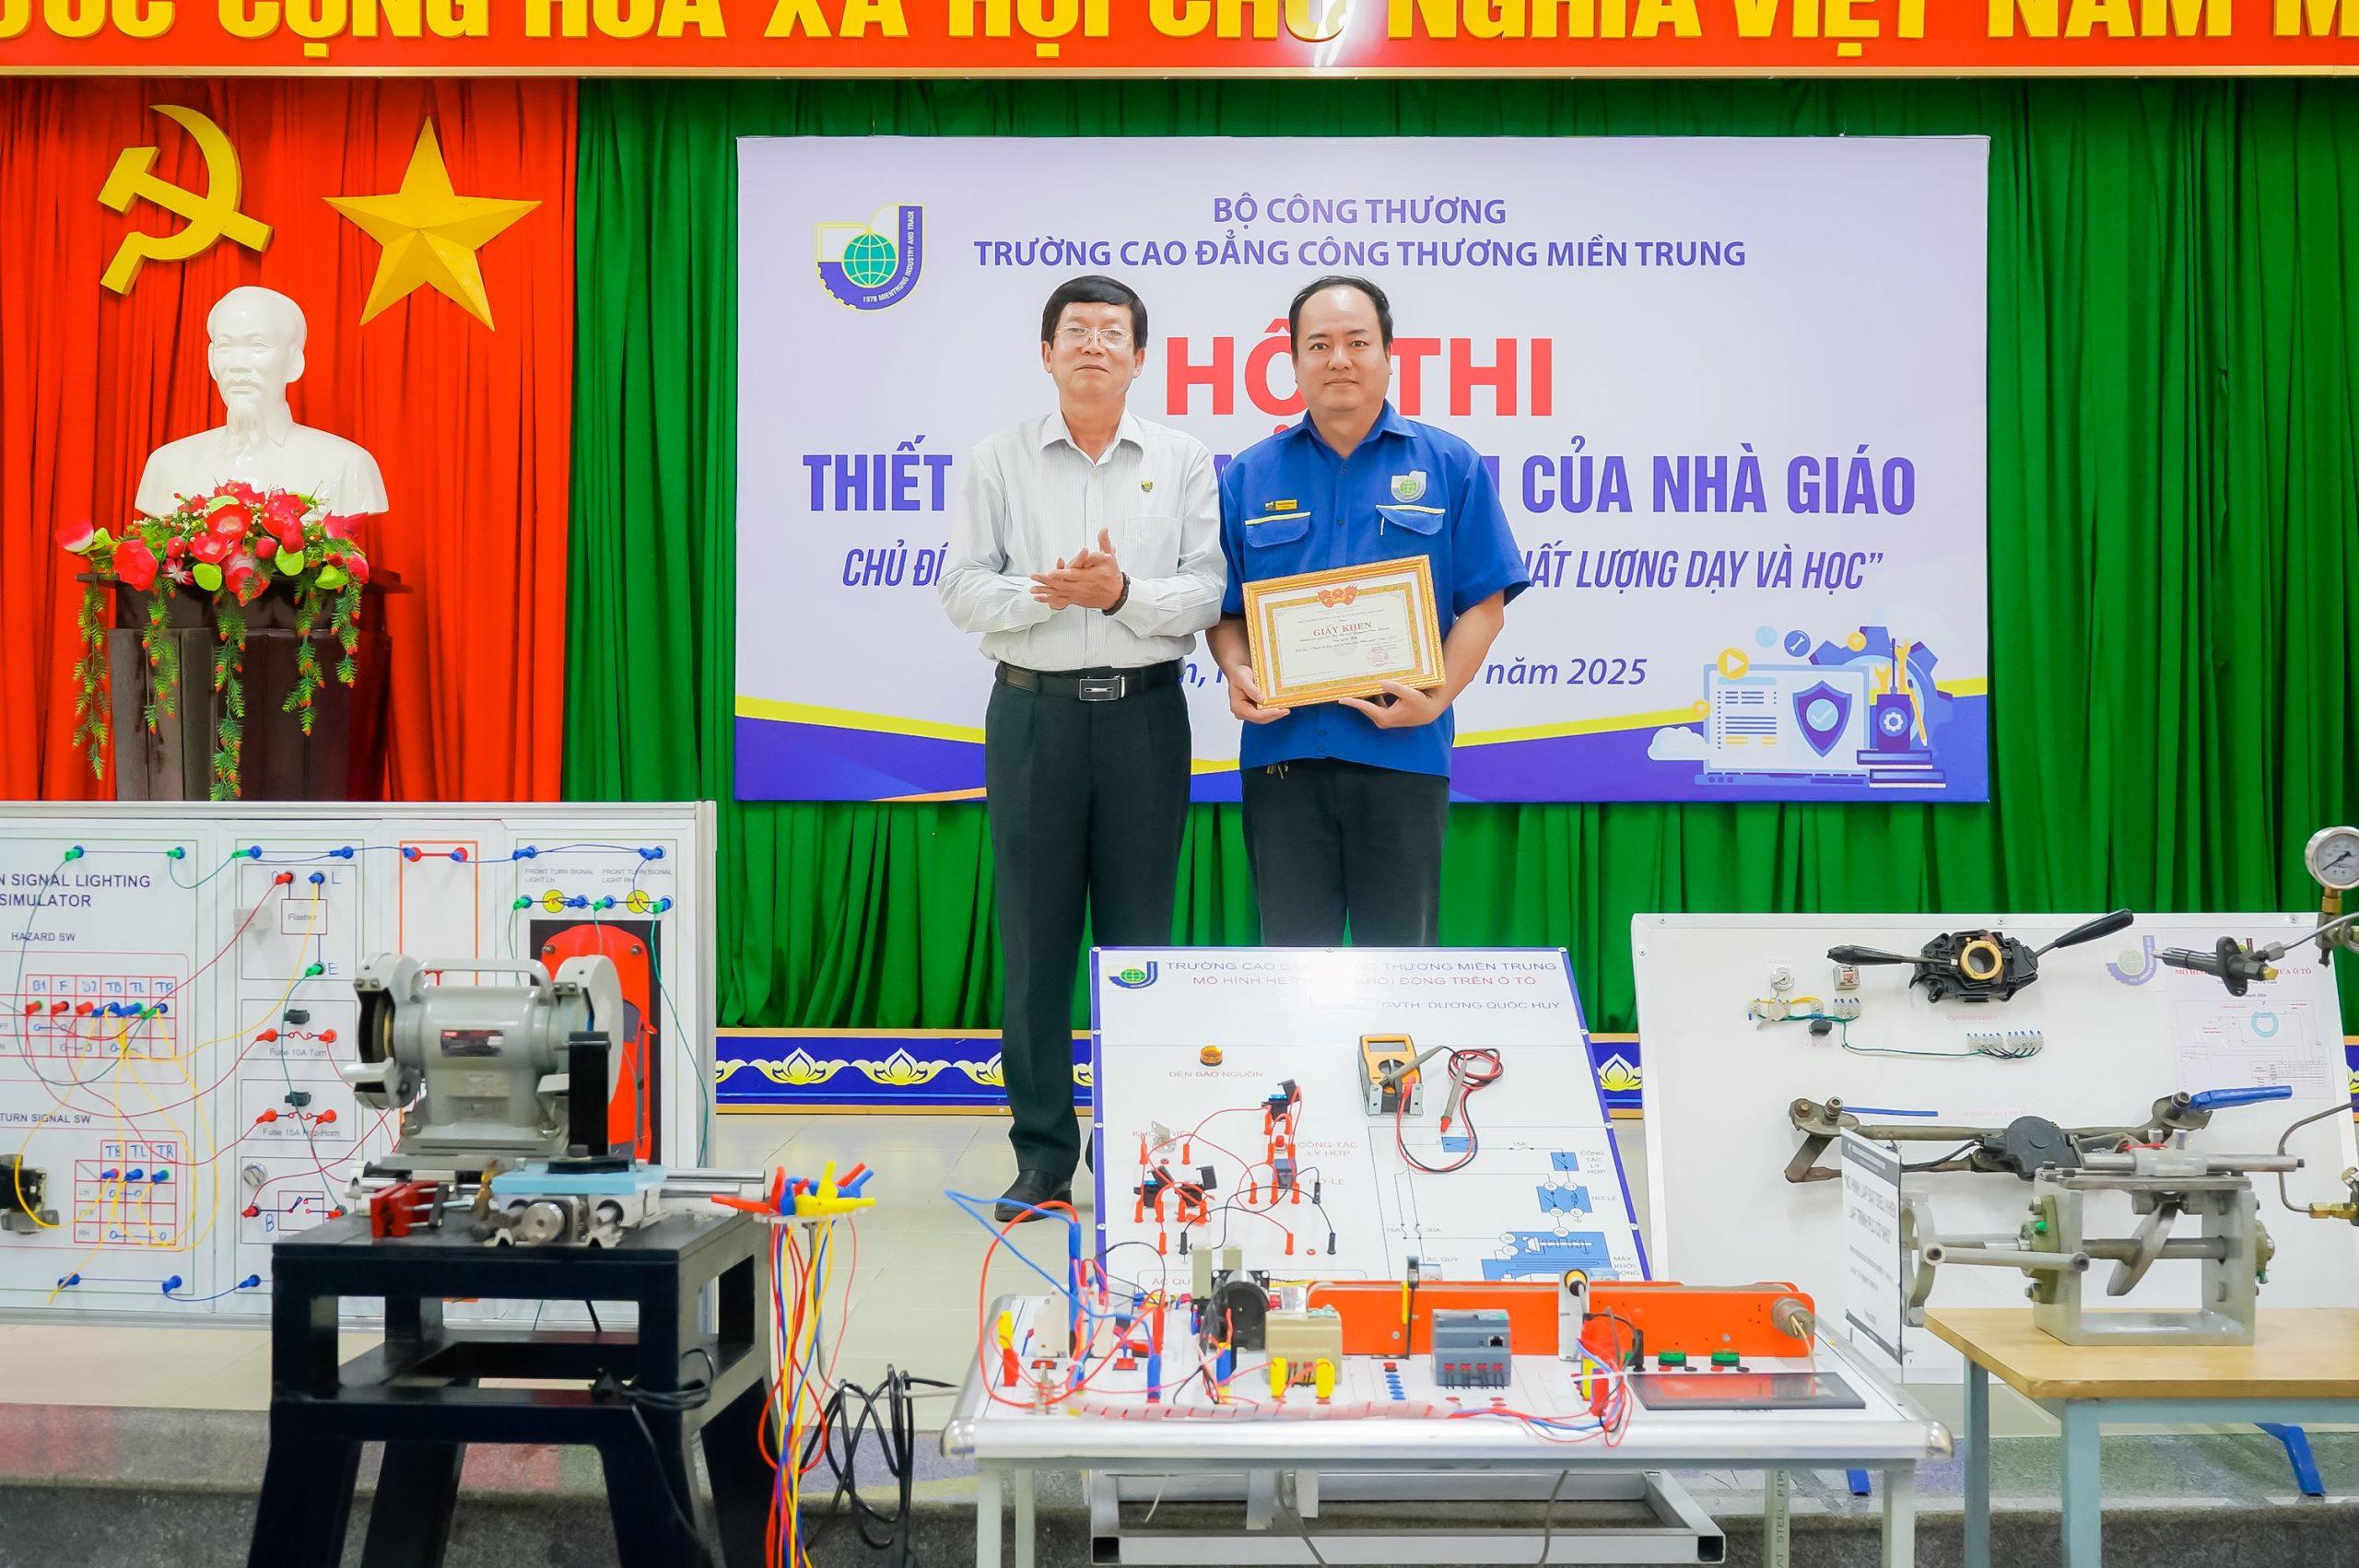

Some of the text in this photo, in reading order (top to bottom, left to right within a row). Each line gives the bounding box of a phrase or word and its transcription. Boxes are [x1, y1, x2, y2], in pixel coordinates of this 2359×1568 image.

[1214, 192, 1506, 229] BỘ CÔNG THƯƠNG
[974, 229, 1746, 267] TRƯỜNG CAO ĐẲNG CÔNG THƯƠNG MIỀN TRUNG
[1388, 338, 1553, 416] THI
[803, 435, 953, 511] THIẾT
[1521, 435, 1633, 514] CỦA
[1659, 442, 1767, 514] NHÀ
[1787, 444, 1916, 515] GIÁO
[842, 538, 908, 587] CHỦ
[1577, 546, 1680, 594] LƯỢNG
[1685, 550, 1749, 594] DẠY
[1757, 542, 1792, 589] VÀ
[1342, 621, 1372, 633] KHEN
[1485, 657, 1648, 685] năm 2025
[11, 873, 70, 887] SIGNAL
[76, 874, 151, 888] LIGHTING
[0, 894, 91, 907] SIMULATOR
[11, 932, 76, 942] HAZARD SW
[328, 962, 338, 976] E
[1241, 962, 1275, 971] CAO
[1500, 962, 1556, 971] TRUNG
[1192, 975, 1218, 985] MÔ
[1532, 1001, 1561, 1010] HUY
[0, 1112, 91, 1124] TURN SIGNAL SW
[265, 1213, 275, 1233] B
